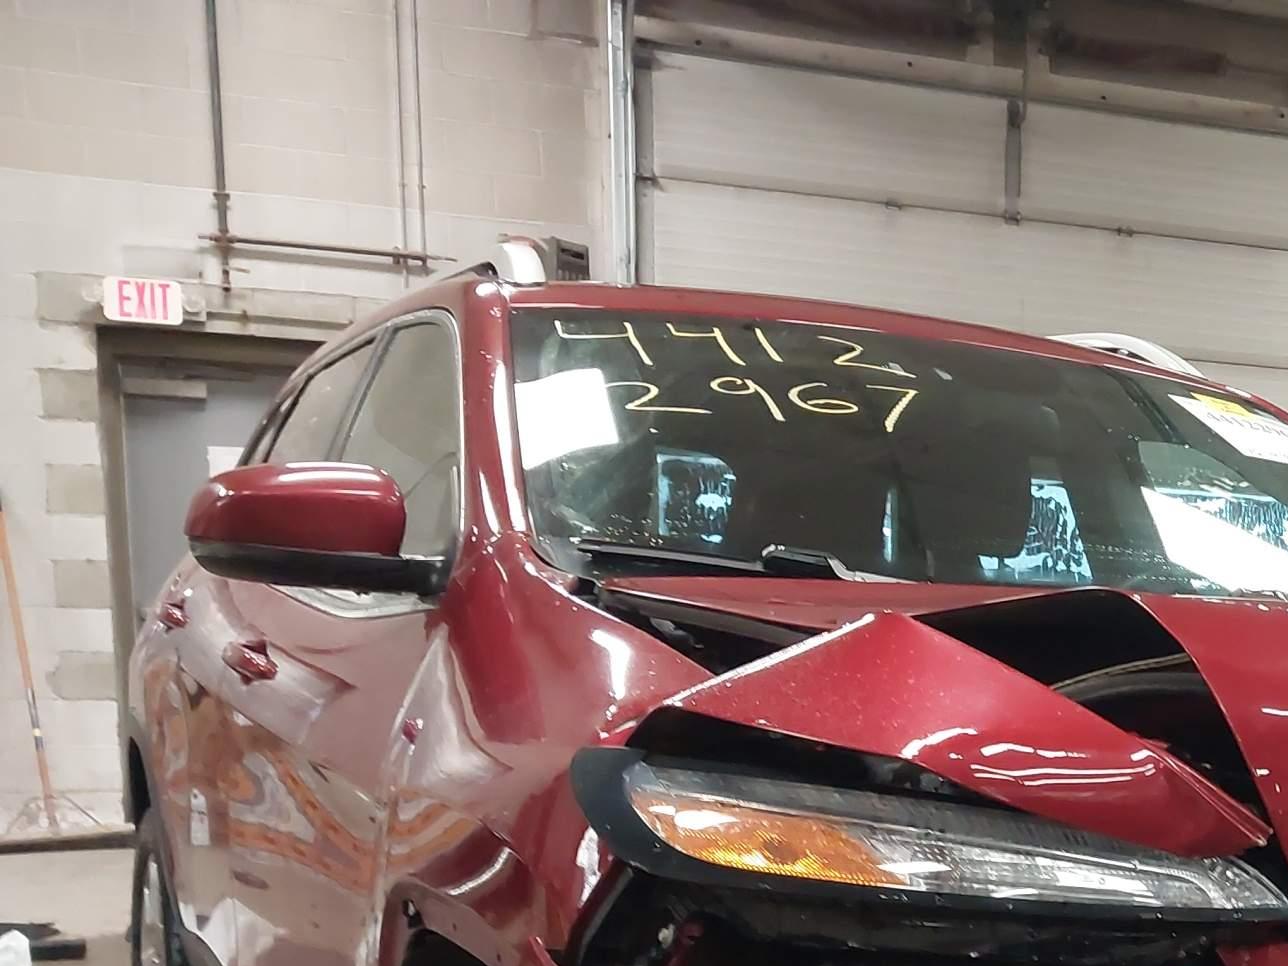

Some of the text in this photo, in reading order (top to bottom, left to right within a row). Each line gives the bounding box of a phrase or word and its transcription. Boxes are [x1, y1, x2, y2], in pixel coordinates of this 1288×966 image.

[117, 280, 171, 320] EXIT
[553, 319, 917, 379] 4412
[604, 376, 919, 432] 2967
